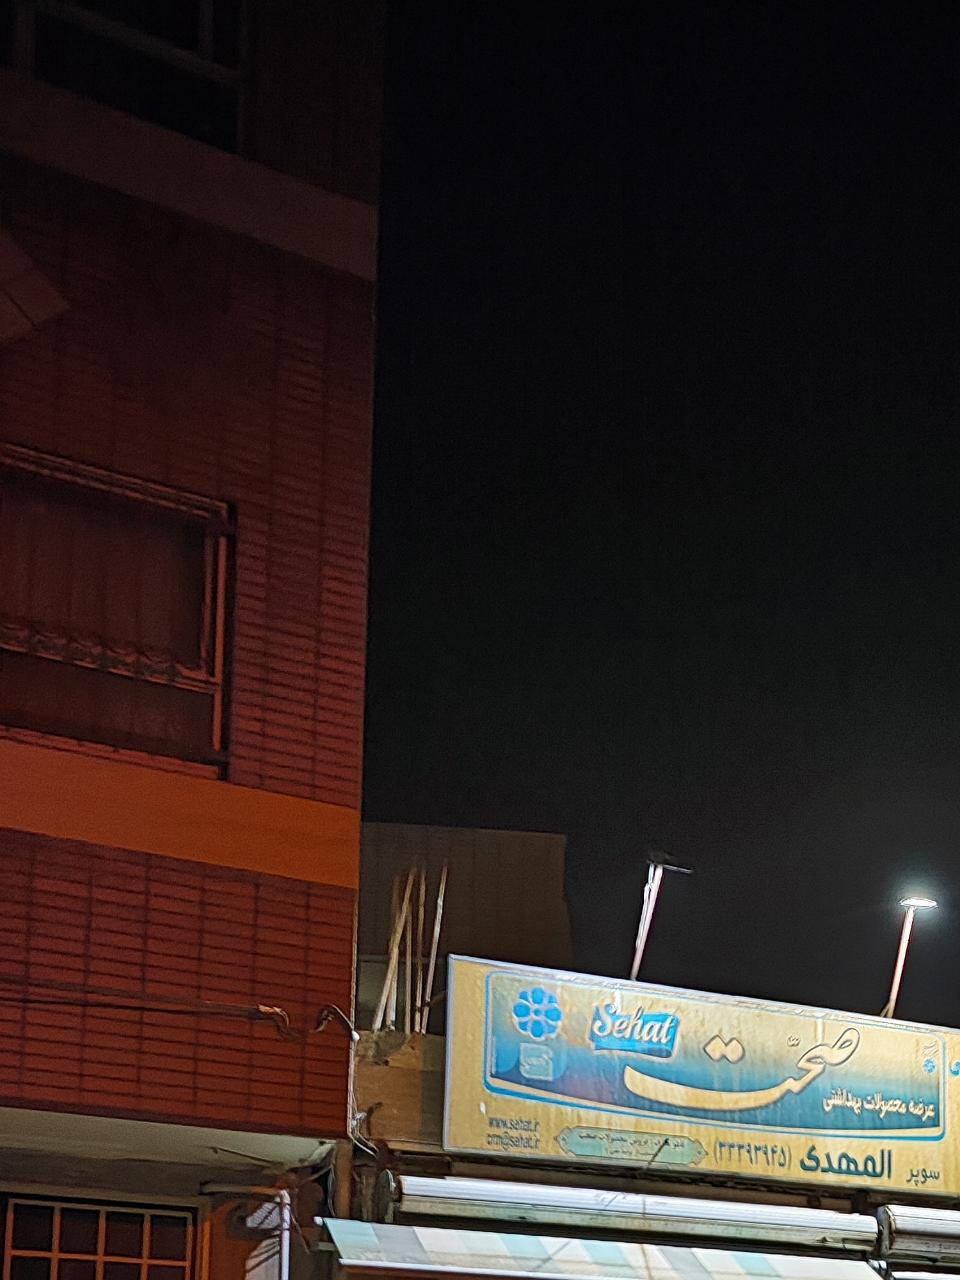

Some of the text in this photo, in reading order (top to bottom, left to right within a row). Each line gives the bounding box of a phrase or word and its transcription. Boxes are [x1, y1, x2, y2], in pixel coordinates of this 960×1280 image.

[593, 1003, 674, 1044] Sehat
[823, 1087, 935, 1121] عرضه محصولات بهداشتی
[906, 1166, 940, 1186] سوپر
